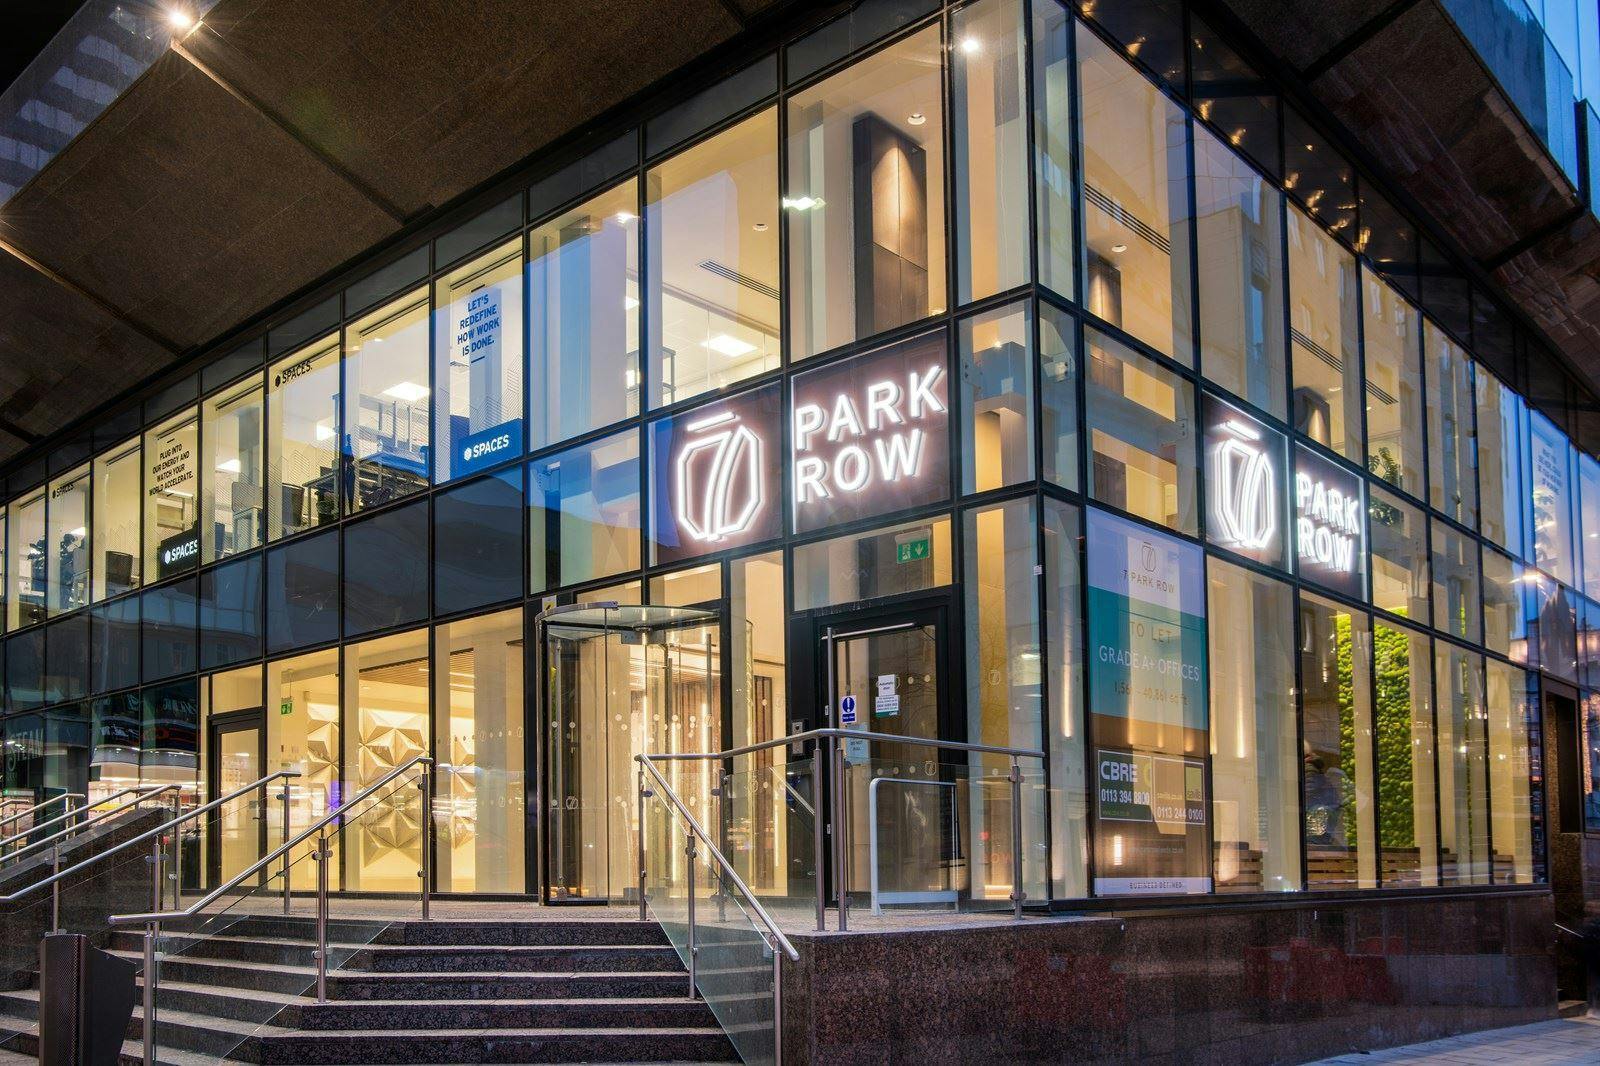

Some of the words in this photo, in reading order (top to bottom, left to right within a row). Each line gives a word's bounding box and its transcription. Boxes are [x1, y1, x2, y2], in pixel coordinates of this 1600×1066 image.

[468, 294, 489, 312] LET'S
[460, 304, 497, 329] REDEFINE
[457, 329, 475, 344] HOW
[477, 317, 500, 335] WORK
[462, 345, 470, 356] IS
[471, 335, 495, 352] DONE.
[797, 365, 947, 450] PARK
[160, 449, 171, 460] PLUG
[172, 443, 182, 455] INTO
[473, 434, 509, 457] SPACES
[152, 464, 161, 474] OUR
[162, 455, 179, 470] ENERGY
[180, 450, 190, 461] AND
[157, 470, 172, 482] WATCH
[173, 464, 185, 475] YOUR
[797, 429, 923, 503] ROW
[149, 484, 163, 496] WORLD
[165, 471, 194, 488] ACCELERATE.
[1296, 472, 1359, 535] PARK
[171, 539, 198, 562] SPACES
[1298, 517, 1354, 573] ROW
[1131, 571, 1155, 588] PARK
[1156, 580, 1175, 593] ROW
[1129, 621, 1145, 638] TO
[1152, 626, 1172, 644] LET
[1099, 645, 1140, 668] GRADE
[1142, 655, 1156, 670] A+
[1158, 658, 1201, 681] OFFICES
[1101, 761, 1138, 783] CBRE
[1101, 788, 1118, 802] 0113
[1120, 790, 1132, 803] 394
[1157, 806, 1173, 820] 0113
[1174, 807, 1187, 820] 244
